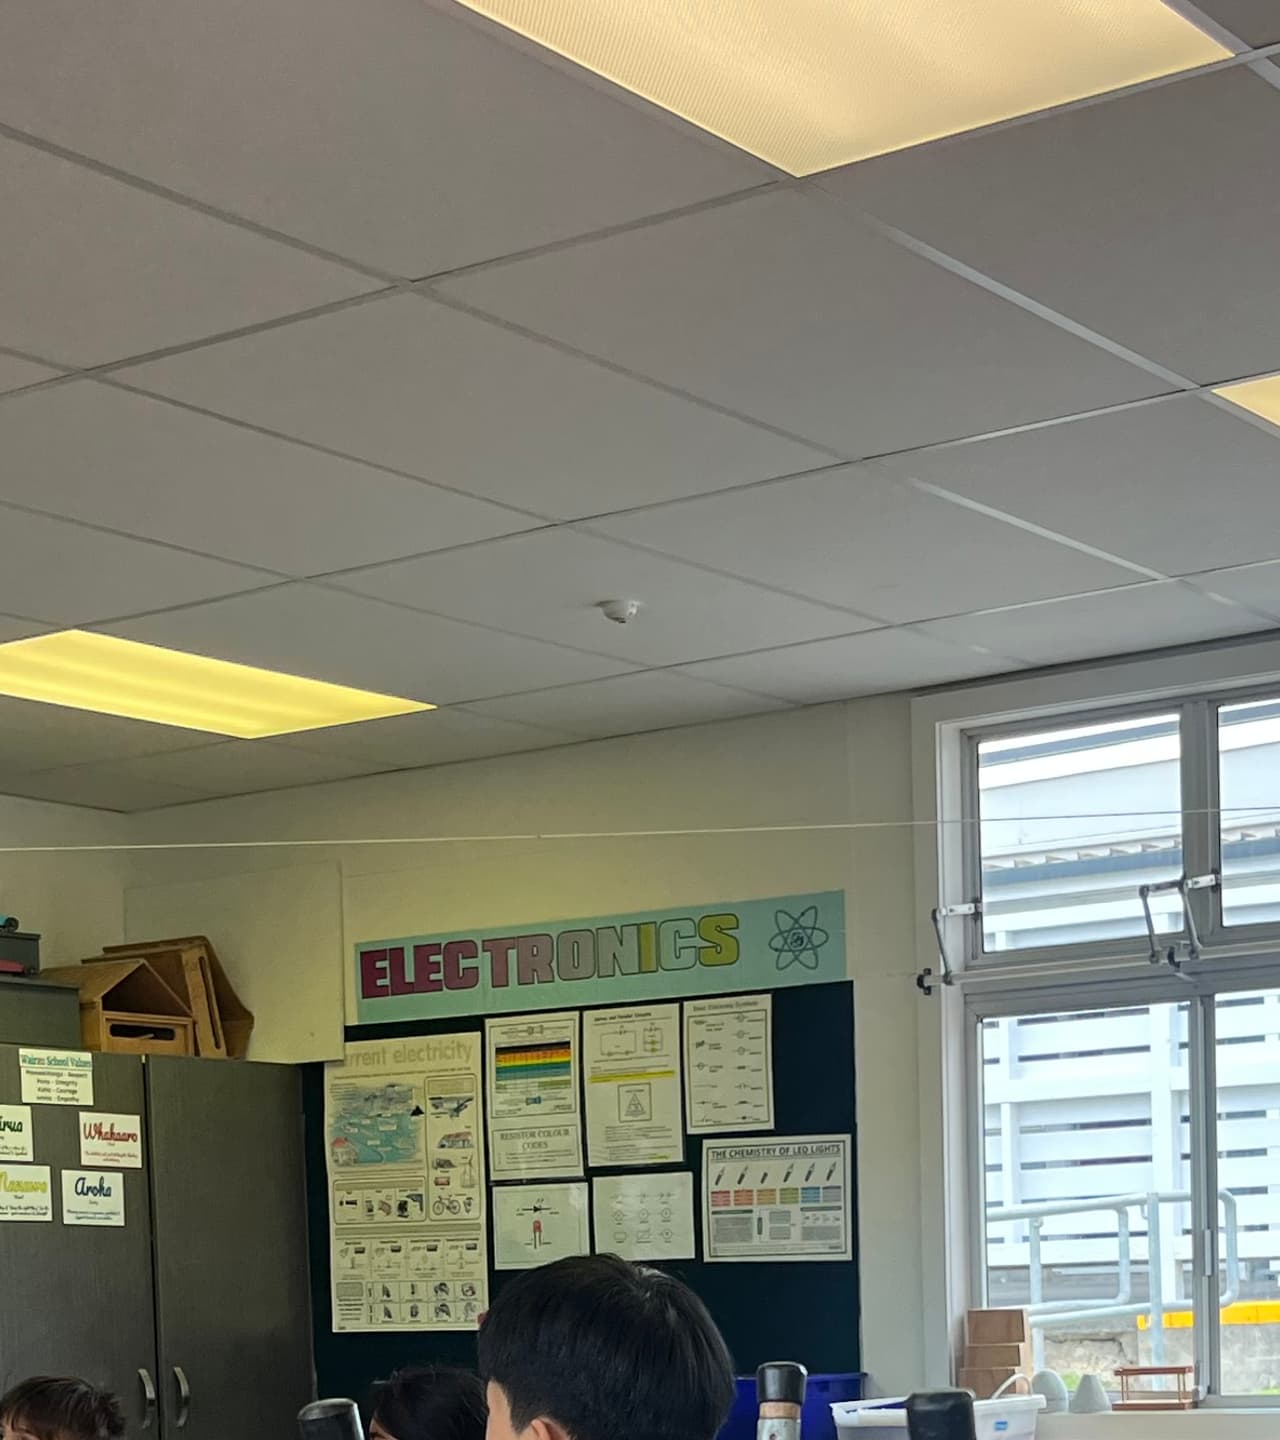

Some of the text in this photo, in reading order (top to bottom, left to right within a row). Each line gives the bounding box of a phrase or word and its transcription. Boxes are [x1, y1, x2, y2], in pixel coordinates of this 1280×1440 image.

[360, 913, 740, 999] ELECTRONICS
[47, 1055, 69, 1067] School
[393, 1039, 473, 1064] electricity
[83, 1121, 138, 1142] Whakaaro
[712, 1144, 841, 1159] THE CHEMISTRY OF LED LIGHTS
[74, 1175, 112, 1197] Aroha
